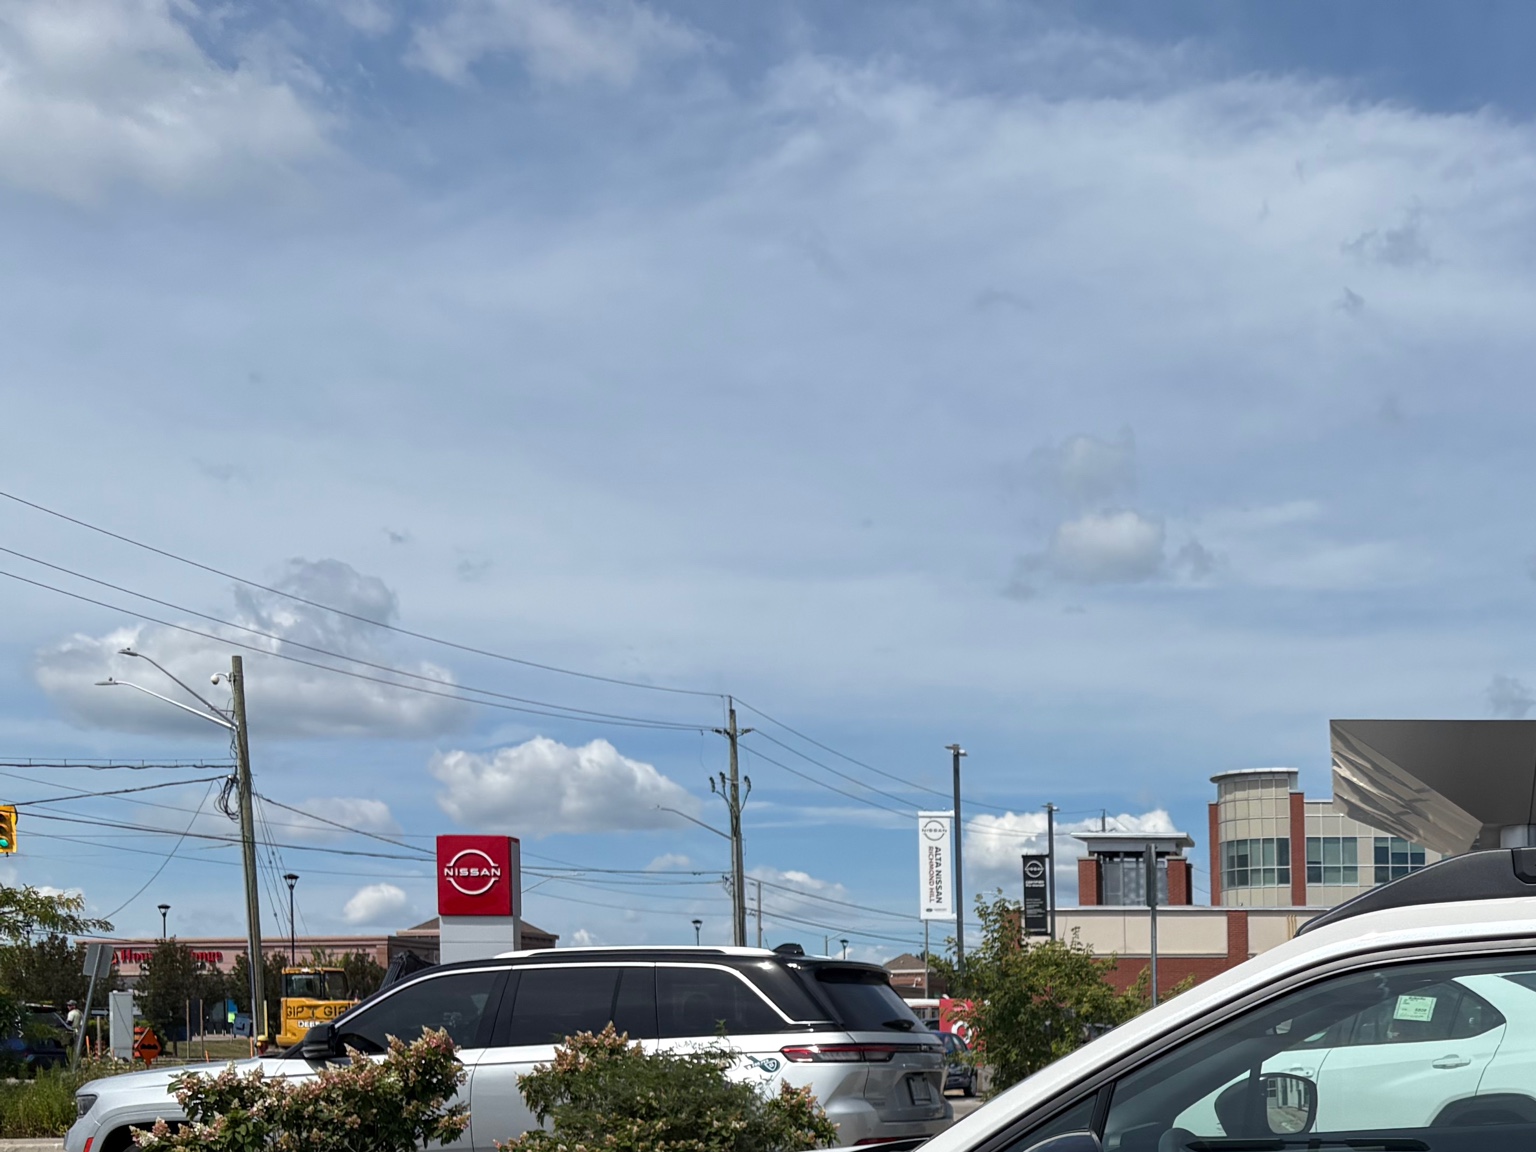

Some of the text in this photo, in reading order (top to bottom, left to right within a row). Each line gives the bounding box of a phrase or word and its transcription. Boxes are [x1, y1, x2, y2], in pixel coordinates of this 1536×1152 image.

[444, 867, 501, 876] NISSAN
[934, 846, 943, 904] ALTA NISSAN
